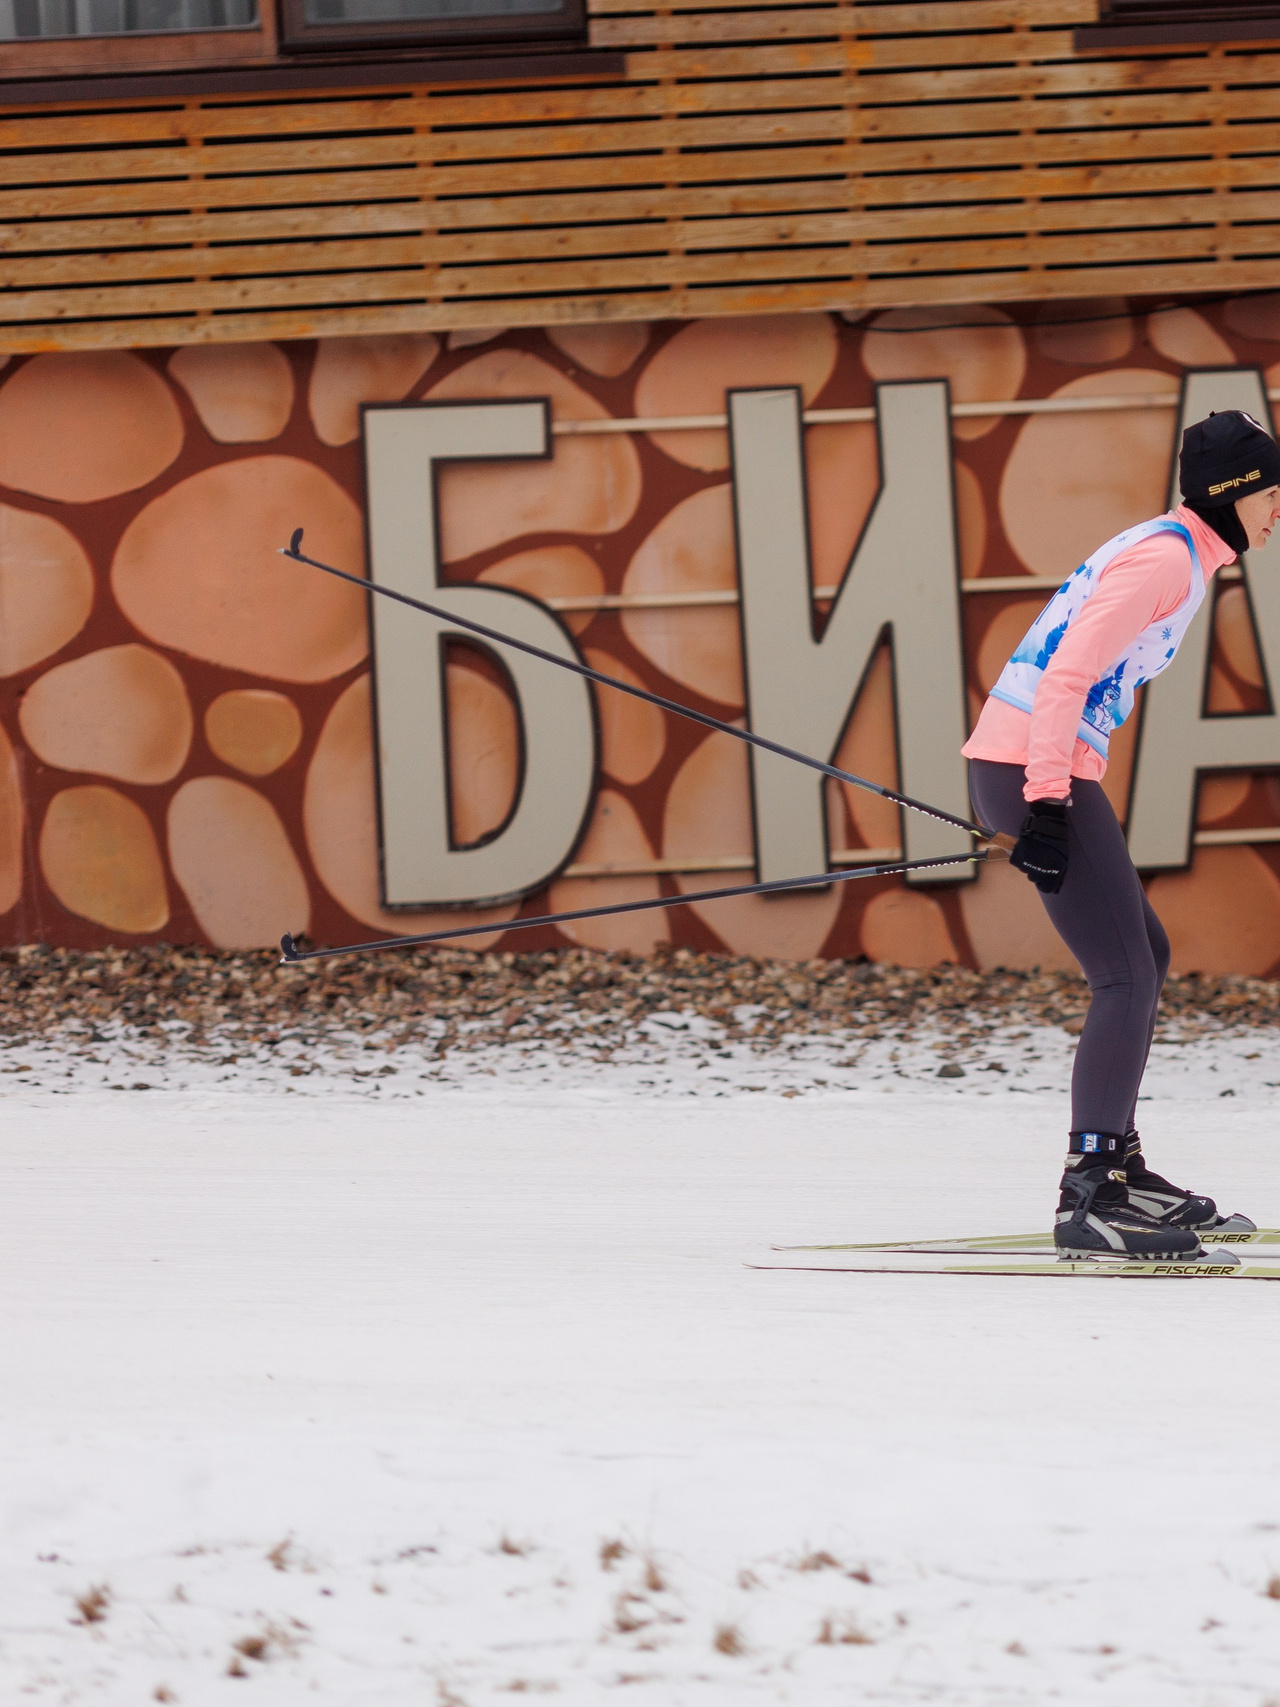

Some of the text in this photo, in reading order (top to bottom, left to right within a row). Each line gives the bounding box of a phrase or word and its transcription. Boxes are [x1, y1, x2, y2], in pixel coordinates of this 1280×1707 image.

[1208, 469, 1261, 495] SPINE
[1200, 1234, 1251, 1243] CHER
[1152, 1266, 1235, 1275] FISCHER
